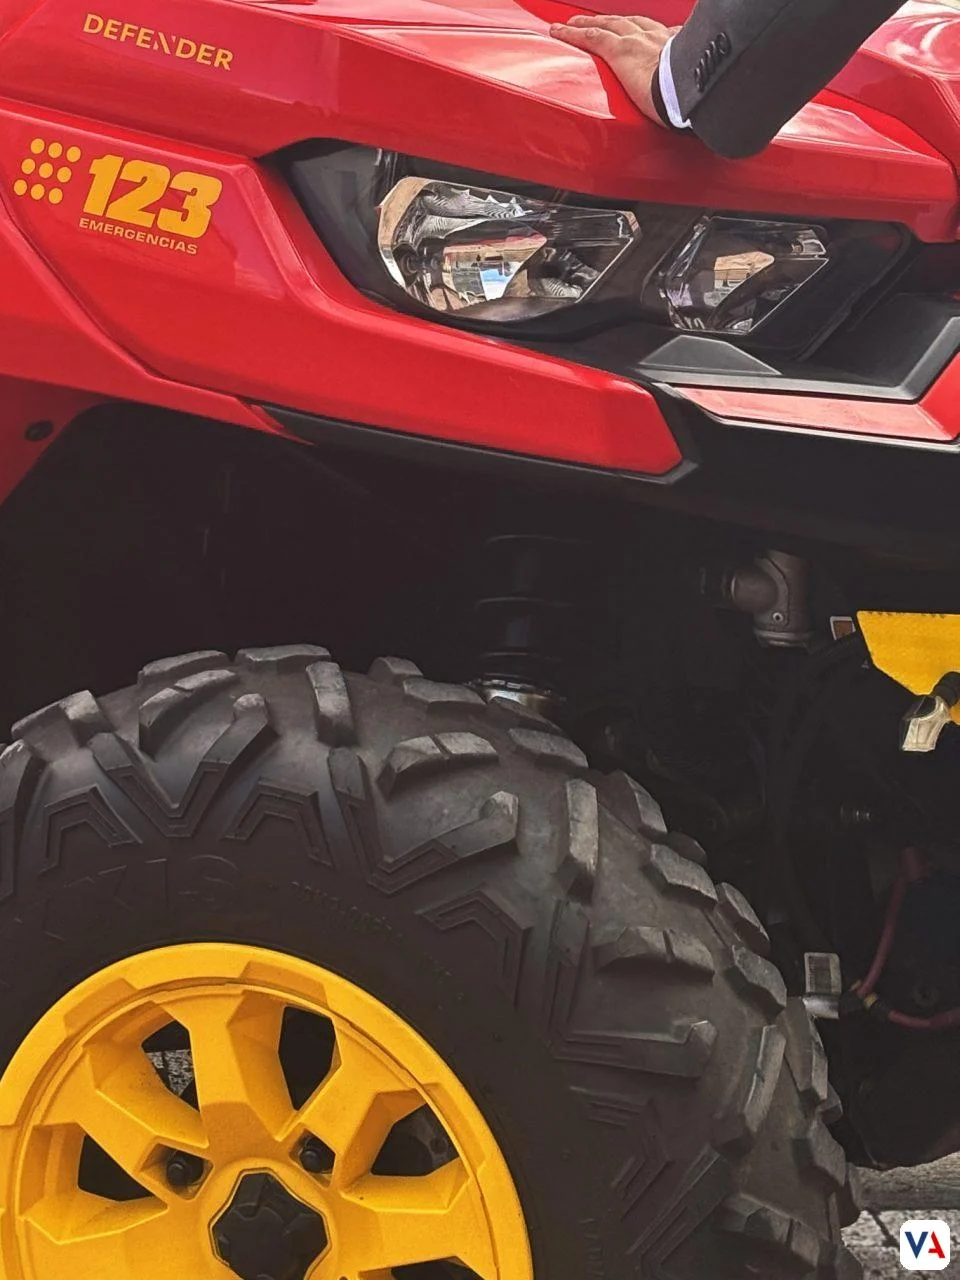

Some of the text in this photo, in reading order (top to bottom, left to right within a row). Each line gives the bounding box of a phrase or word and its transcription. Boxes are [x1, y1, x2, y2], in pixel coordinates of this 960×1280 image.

[83, 13, 234, 71] DEFENDER
[83, 153, 223, 239] 123
[78, 217, 199, 256] EMERGENCIAS
